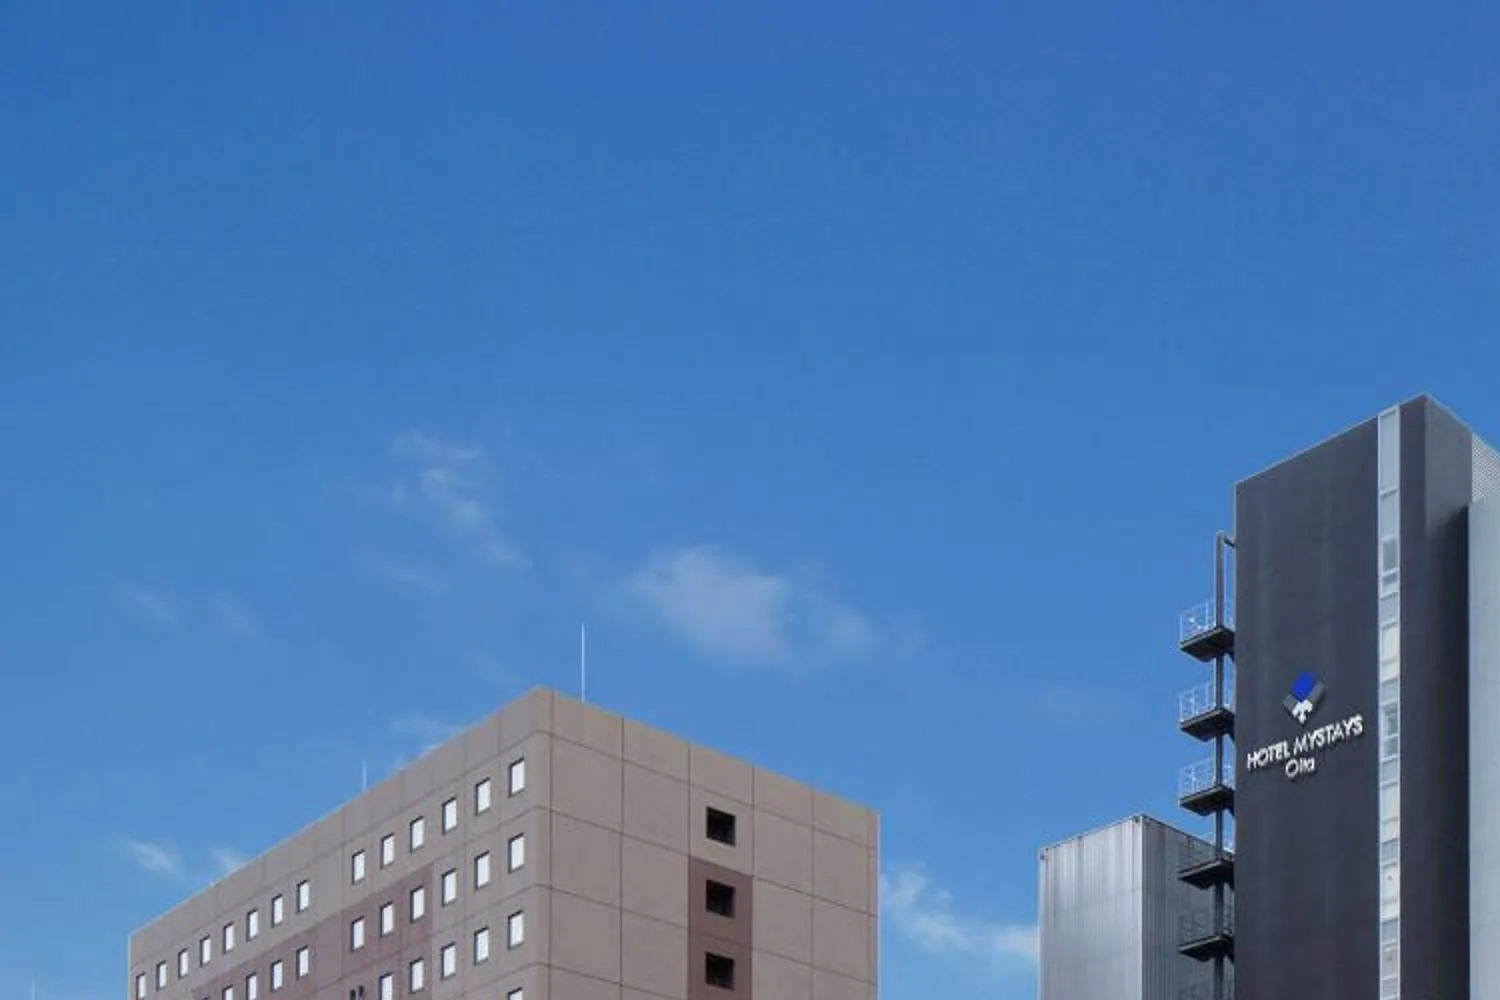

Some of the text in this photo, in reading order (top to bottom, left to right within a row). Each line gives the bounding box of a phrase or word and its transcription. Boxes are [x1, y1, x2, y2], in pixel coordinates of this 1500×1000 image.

[1246, 714, 1364, 770] HOTEL MYSTAYS
[1285, 757, 1315, 778] Oita
